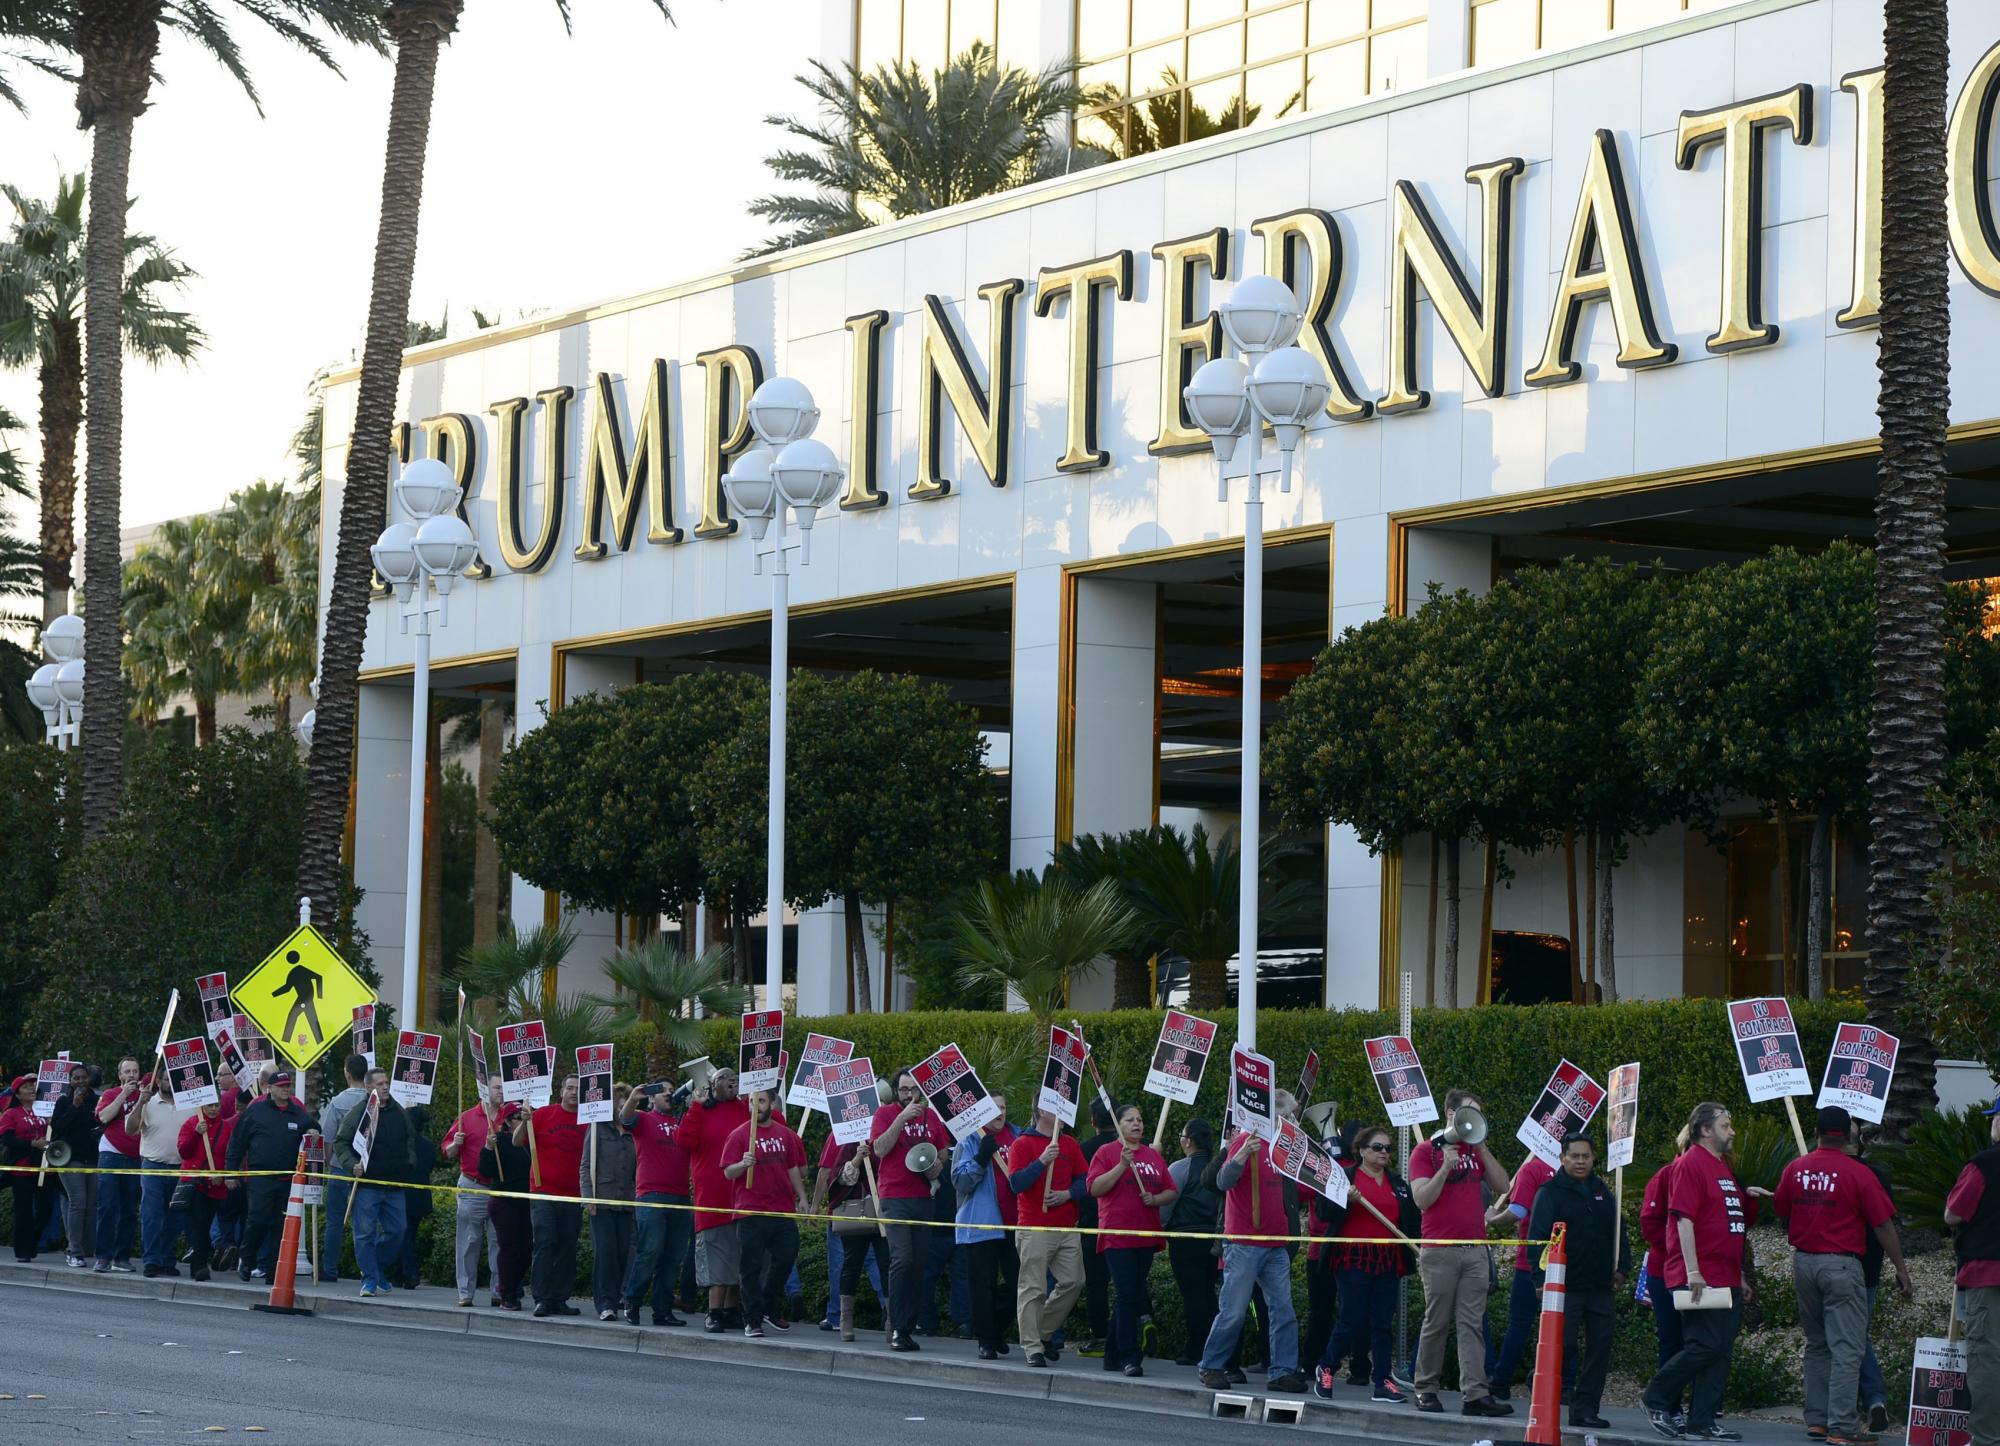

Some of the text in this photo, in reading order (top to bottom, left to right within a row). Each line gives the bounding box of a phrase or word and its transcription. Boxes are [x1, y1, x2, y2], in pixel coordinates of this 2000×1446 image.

[346, 345, 764, 598] RUMP
[1752, 1001, 1770, 1019] NO
[755, 1012, 769, 1027] NO
[1183, 1018, 1197, 1032] NO
[1737, 1016, 1792, 1038] CONTRACT
[413, 1034, 426, 1046] NO
[514, 1025, 527, 1040] NO
[744, 1025, 780, 1042] CONTRACT
[1164, 1027, 1209, 1052] CONTRACT
[1860, 1028, 1878, 1043] NO
[177, 1042, 190, 1054] NO
[399, 1044, 437, 1061] CONTRACT
[501, 1036, 543, 1054] CONTRACT
[754, 1042, 767, 1058] NO
[822, 1039, 836, 1051] NO
[1380, 1038, 1397, 1055] NO
[1761, 1036, 1780, 1056] NO
[168, 1050, 205, 1069] CONTRACT
[517, 1052, 531, 1067] NO
[1173, 1048, 1188, 1064] NO
[1372, 1050, 1417, 1072] CONTRACT
[1757, 1052, 1793, 1073] PEACE
[1837, 1041, 1892, 1067] CONTRACT
[409, 1059, 422, 1073] NO
[512, 1064, 539, 1080] PEACE
[580, 1058, 610, 1075] CONTRACT
[748, 1055, 772, 1072] PEACE
[837, 1063, 853, 1079] NO
[927, 1056, 944, 1074] NO
[1163, 1059, 1191, 1080] PEACE
[1244, 1061, 1257, 1072] NO
[1850, 1060, 1870, 1077] NO
[40, 1071, 70, 1081] CONTRA
[183, 1066, 196, 1080] NO
[402, 1070, 425, 1086] PEACE
[922, 1058, 967, 1094] CONTRACT
[1236, 1065, 1270, 1086] JUSTICE
[1391, 1069, 1408, 1088] NO
[180, 1075, 205, 1091] PEACE
[826, 1072, 872, 1095] CONTRACT
[1572, 1074, 1588, 1093] NO
[1755, 1079, 1806, 1092] CULINARY WORKERS
[1838, 1074, 1875, 1095] PEACE
[843, 1091, 860, 1107] NO
[944, 1082, 963, 1102] NO
[1245, 1088, 1258, 1099] NO
[1389, 1083, 1420, 1103] PEACE
[1551, 1077, 1593, 1118] CONTRACT
[946, 1090, 978, 1116] PEACE
[1240, 1094, 1266, 1112] PEACE
[1824, 1098, 1878, 1114] CULINARY WORKERS
[840, 1103, 871, 1121] PEACE
[1552, 1103, 1570, 1122] NO
[1540, 1111, 1567, 1140] PEACE
[1277, 1134, 1293, 1153] NO
[1304, 1151, 1320, 1171] NO
[1730, 1222, 1745, 1233] 16
[1918, 1349, 1949, 1358] WORKERS
[1928, 1370, 1965, 1390] PEACE
[1937, 1388, 1954, 1408] NO
[1912, 1409, 1970, 1431] CONTRACT
[1933, 1430, 1950, 1446] NO
